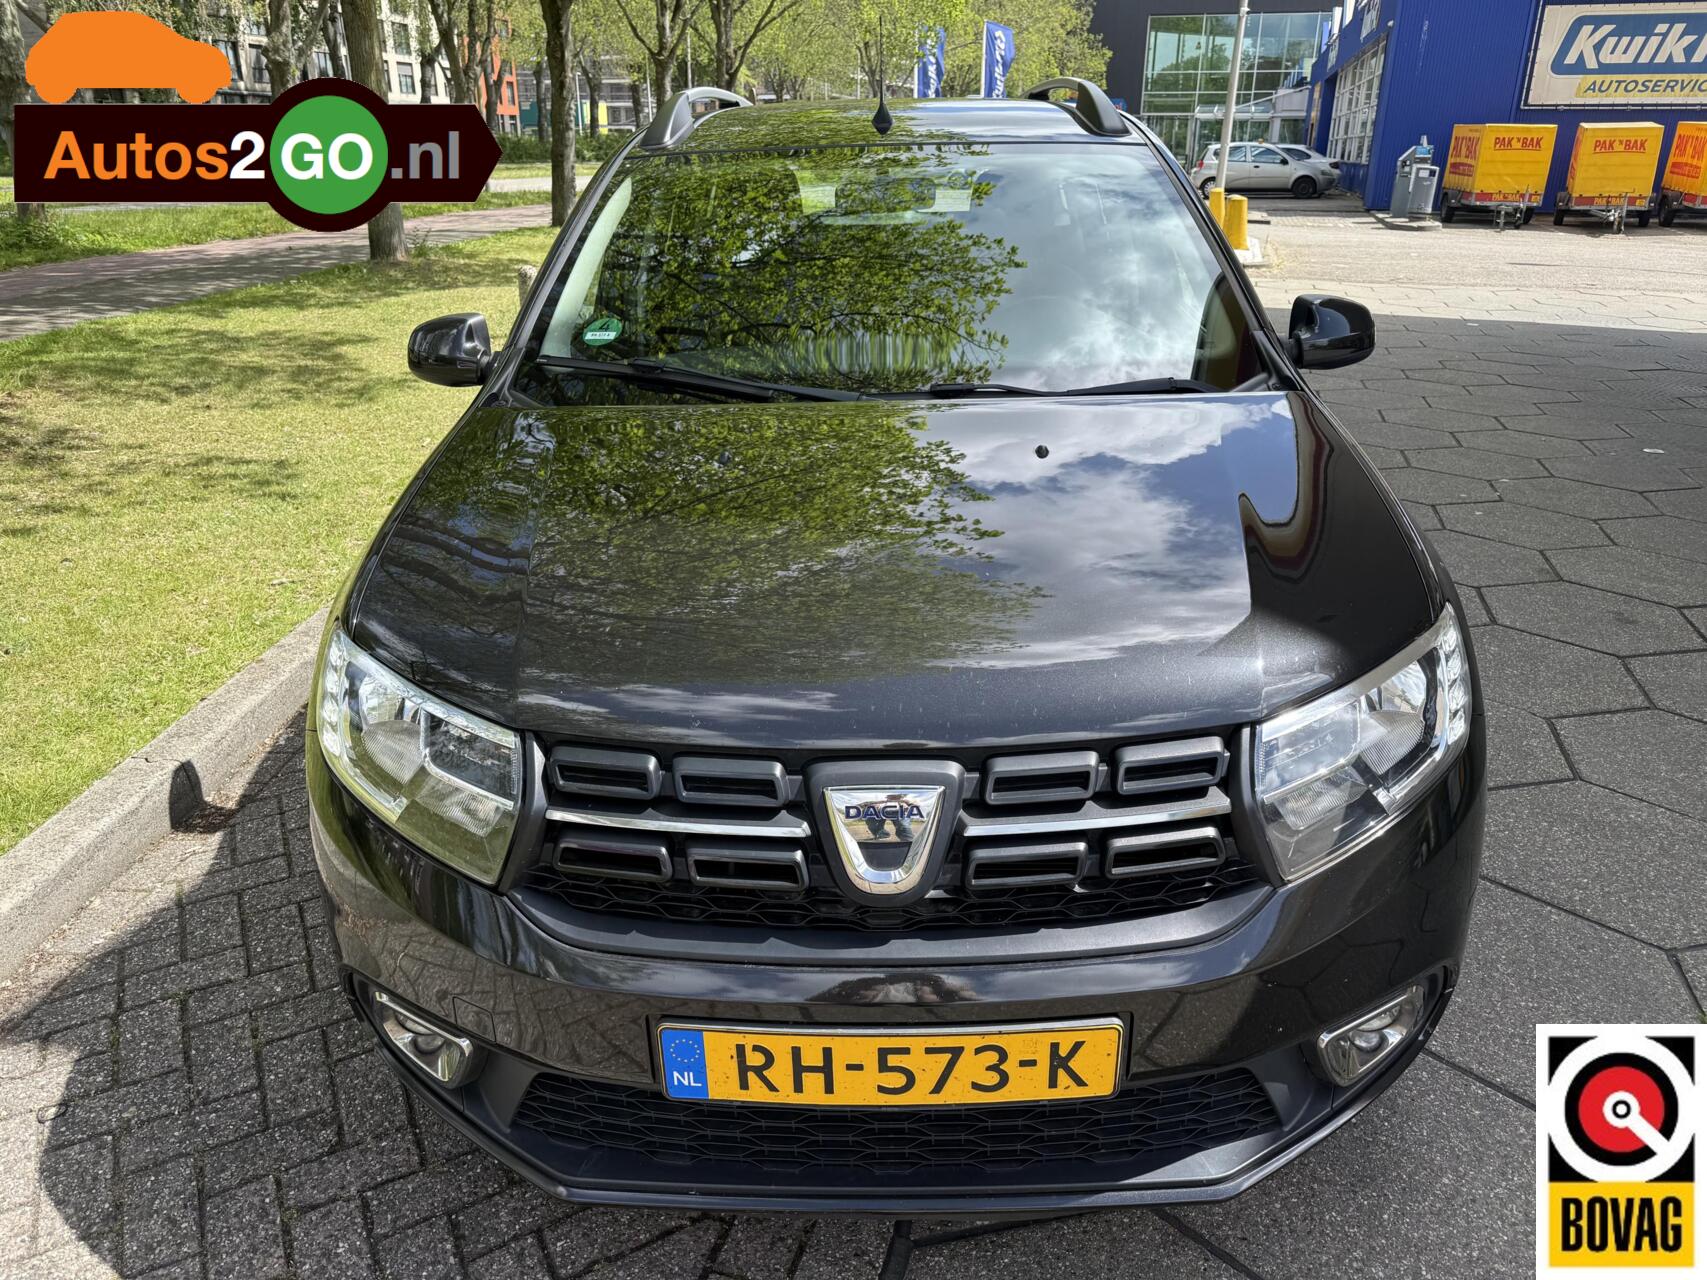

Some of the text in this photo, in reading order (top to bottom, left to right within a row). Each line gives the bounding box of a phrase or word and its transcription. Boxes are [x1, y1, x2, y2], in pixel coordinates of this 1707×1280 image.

[1493, 137, 1514, 149] PAK
[1521, 136, 1544, 149] BAK
[1593, 139, 1616, 152] PAK
[1623, 139, 1648, 151] BAK
[844, 805, 925, 820] DACIA
[735, 1040, 1088, 1095] RH-573-K
[672, 1071, 702, 1087] NL
